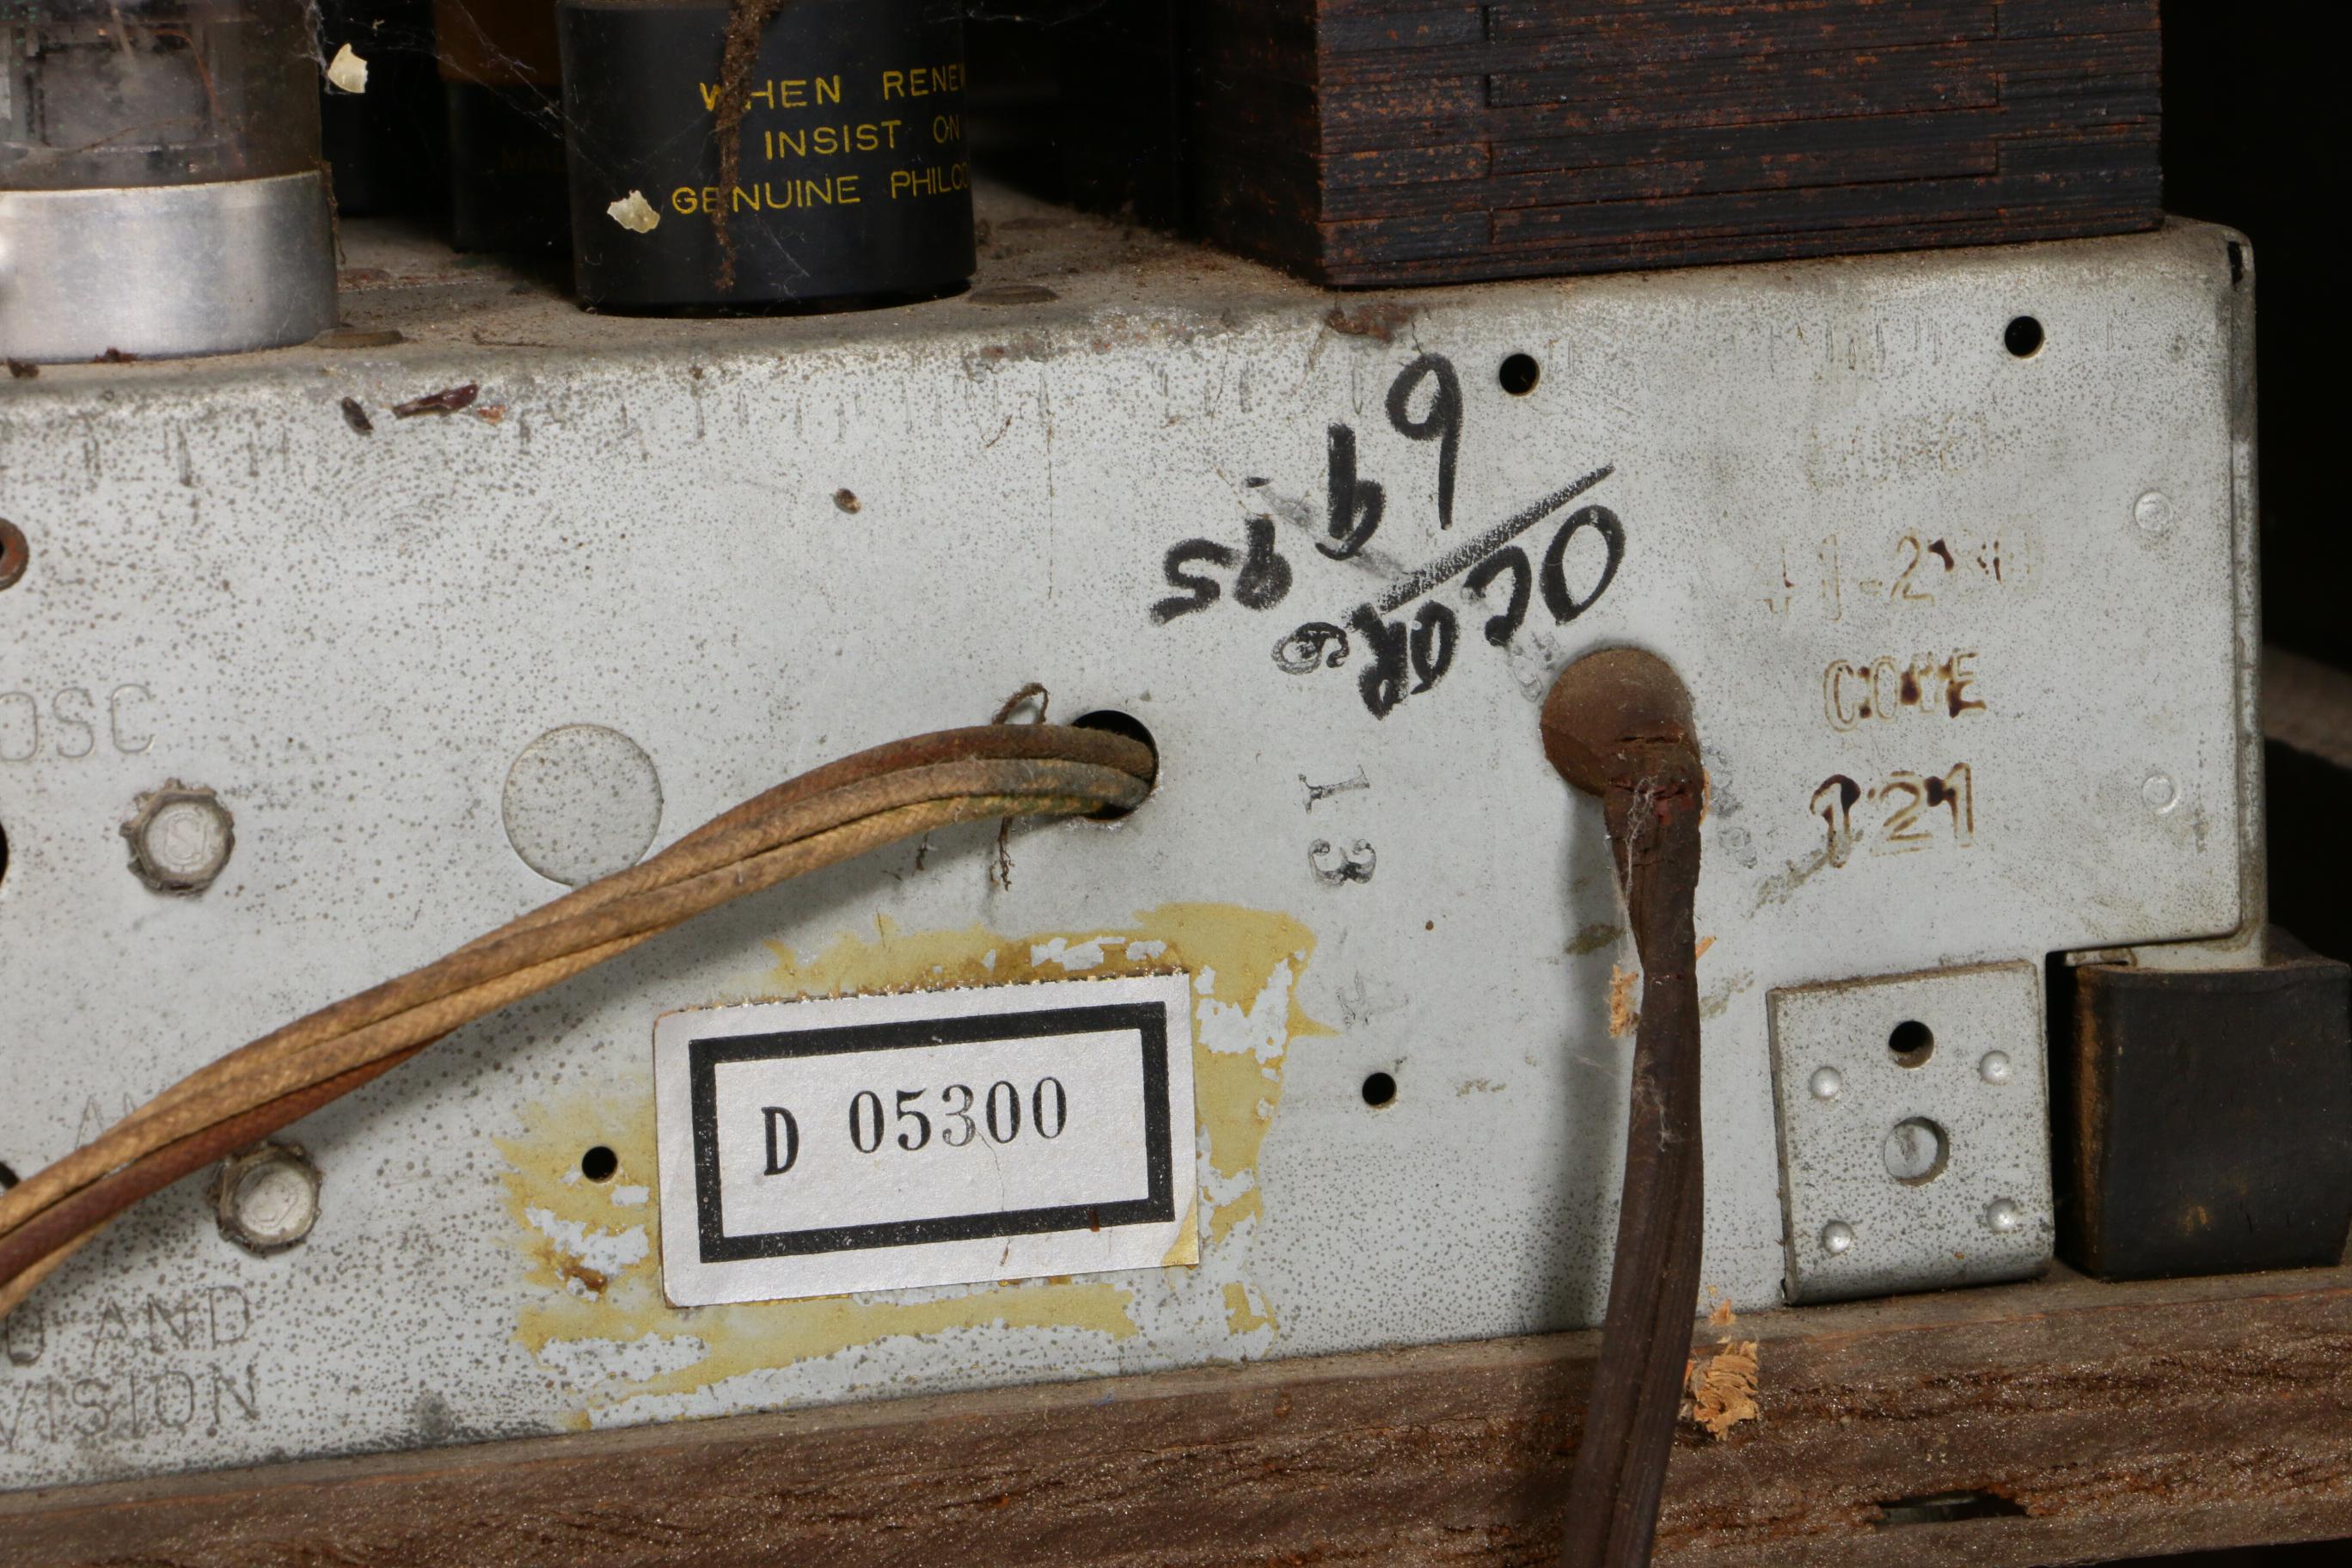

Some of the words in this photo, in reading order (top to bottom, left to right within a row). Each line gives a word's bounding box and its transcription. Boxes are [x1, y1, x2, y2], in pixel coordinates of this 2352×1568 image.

[700, 75, 841, 113] WHEN
[765, 119, 902, 160] INSIST
[933, 113, 961, 144] ON
[671, 175, 861, 215] GENUINE
[890, 161, 970, 200] PHILCO
[0, 683, 155, 763] OSC
[760, 1106, 799, 1176] D
[848, 1075, 1068, 1154] 05300
[90, 1285, 252, 1360] AND
